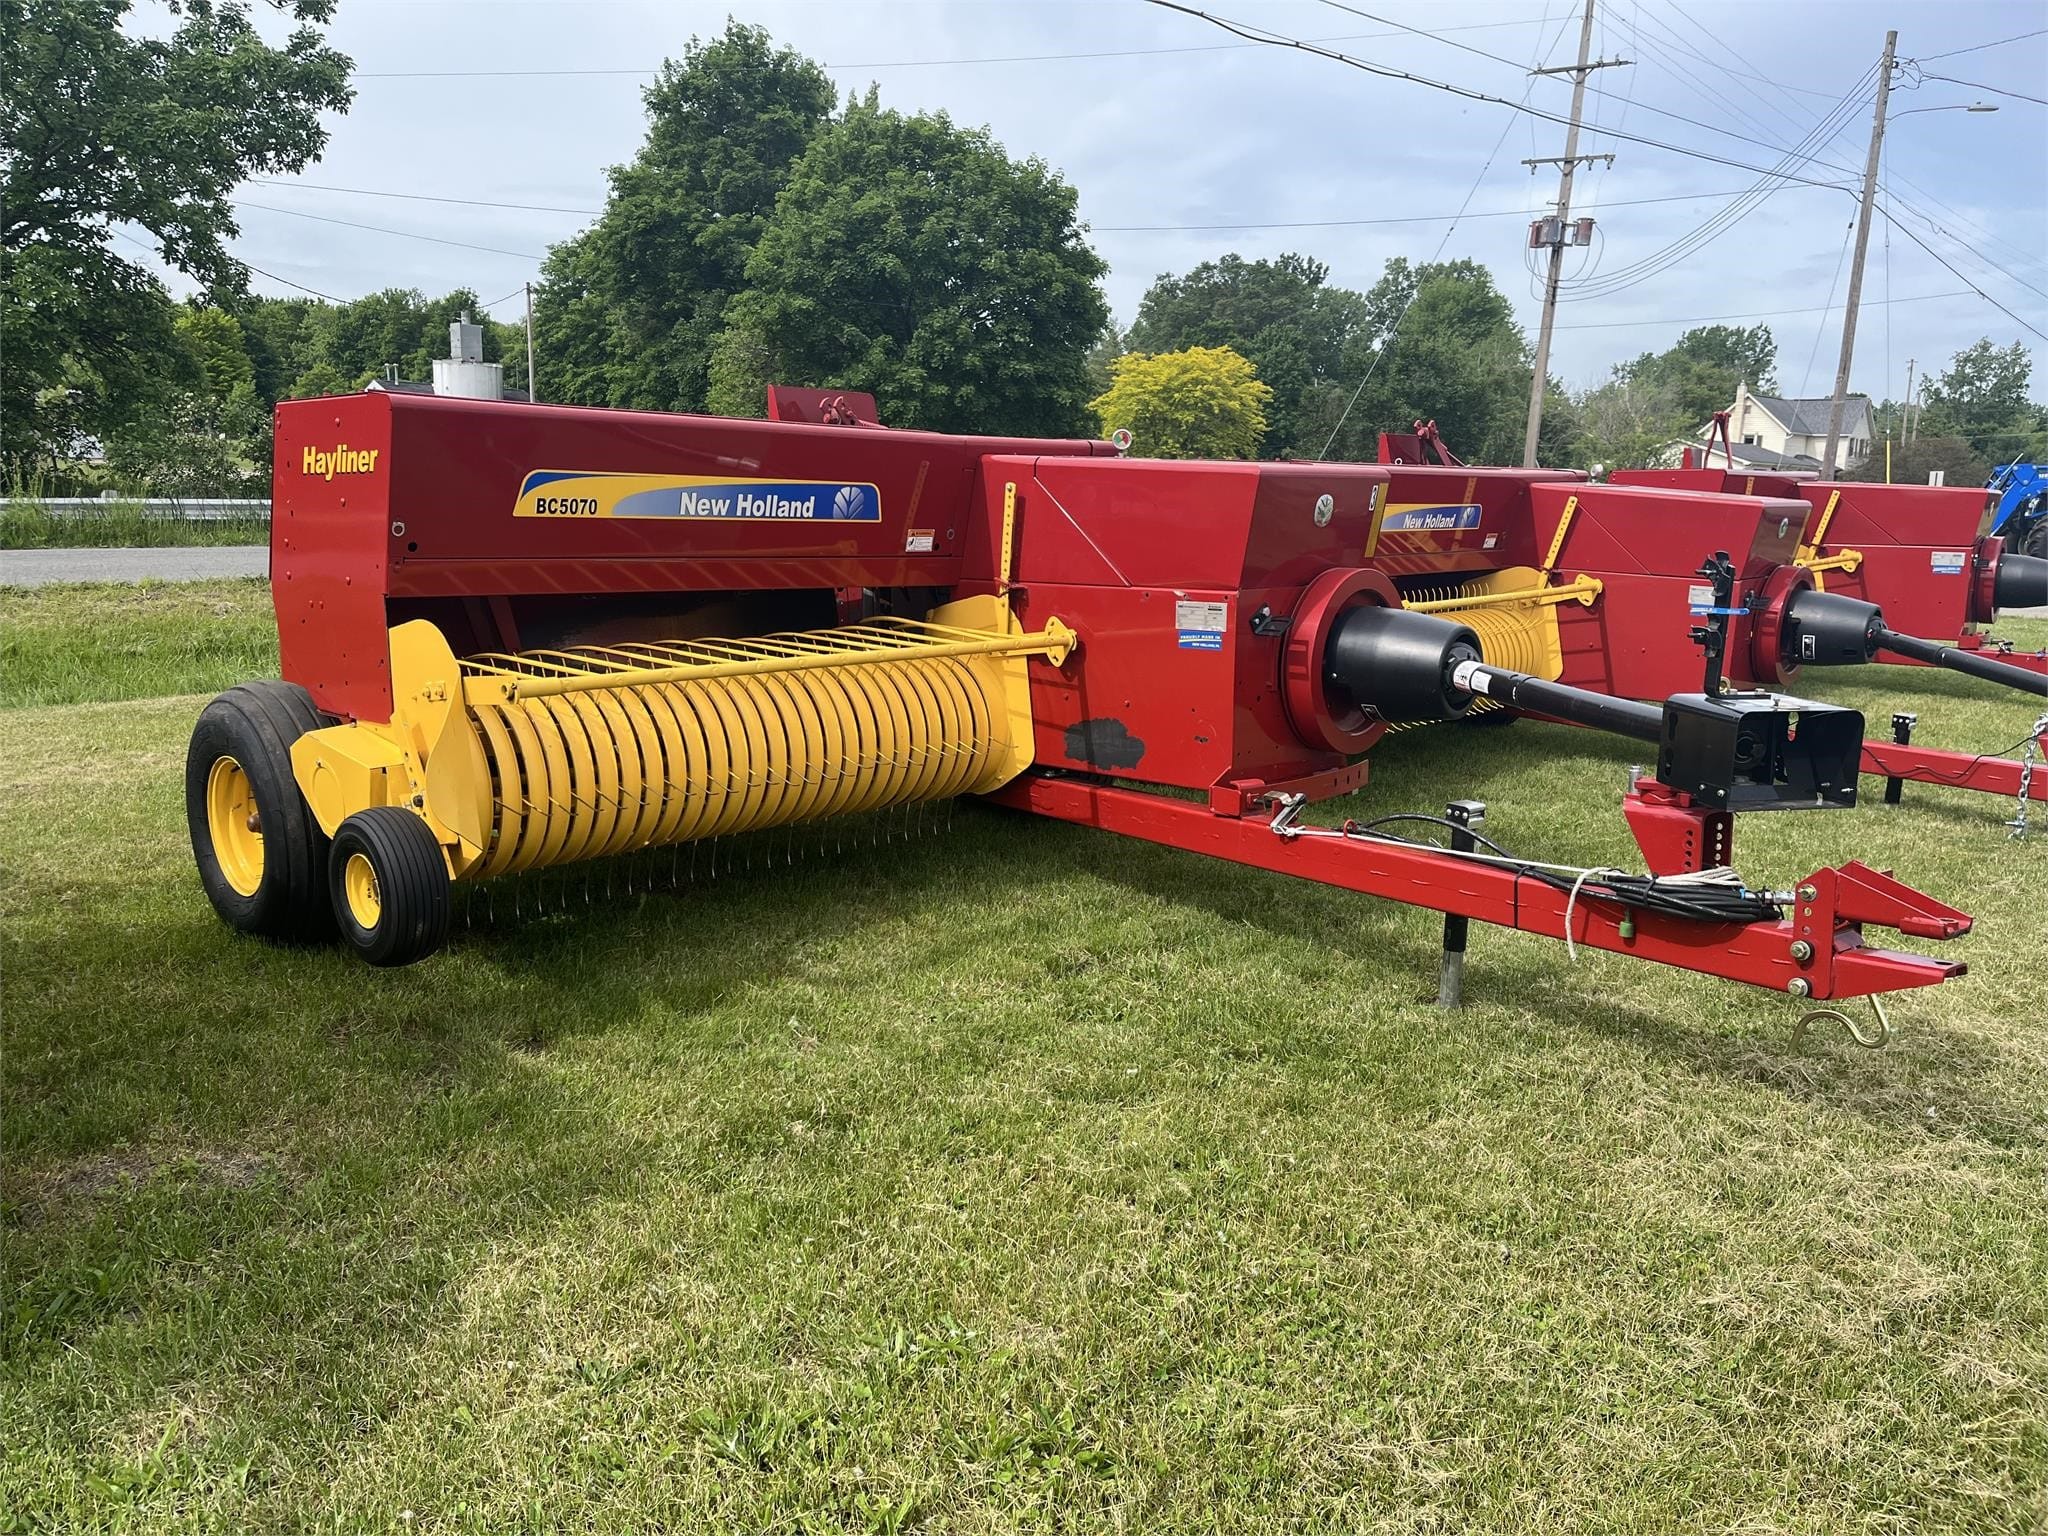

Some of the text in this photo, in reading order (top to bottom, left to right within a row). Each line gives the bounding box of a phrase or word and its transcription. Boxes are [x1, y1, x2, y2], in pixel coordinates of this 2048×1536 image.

[302, 443, 379, 482] Hayliner
[536, 497, 598, 515] BC5070
[680, 492, 815, 518] New Holland
[1403, 513, 1456, 528] New Holland
